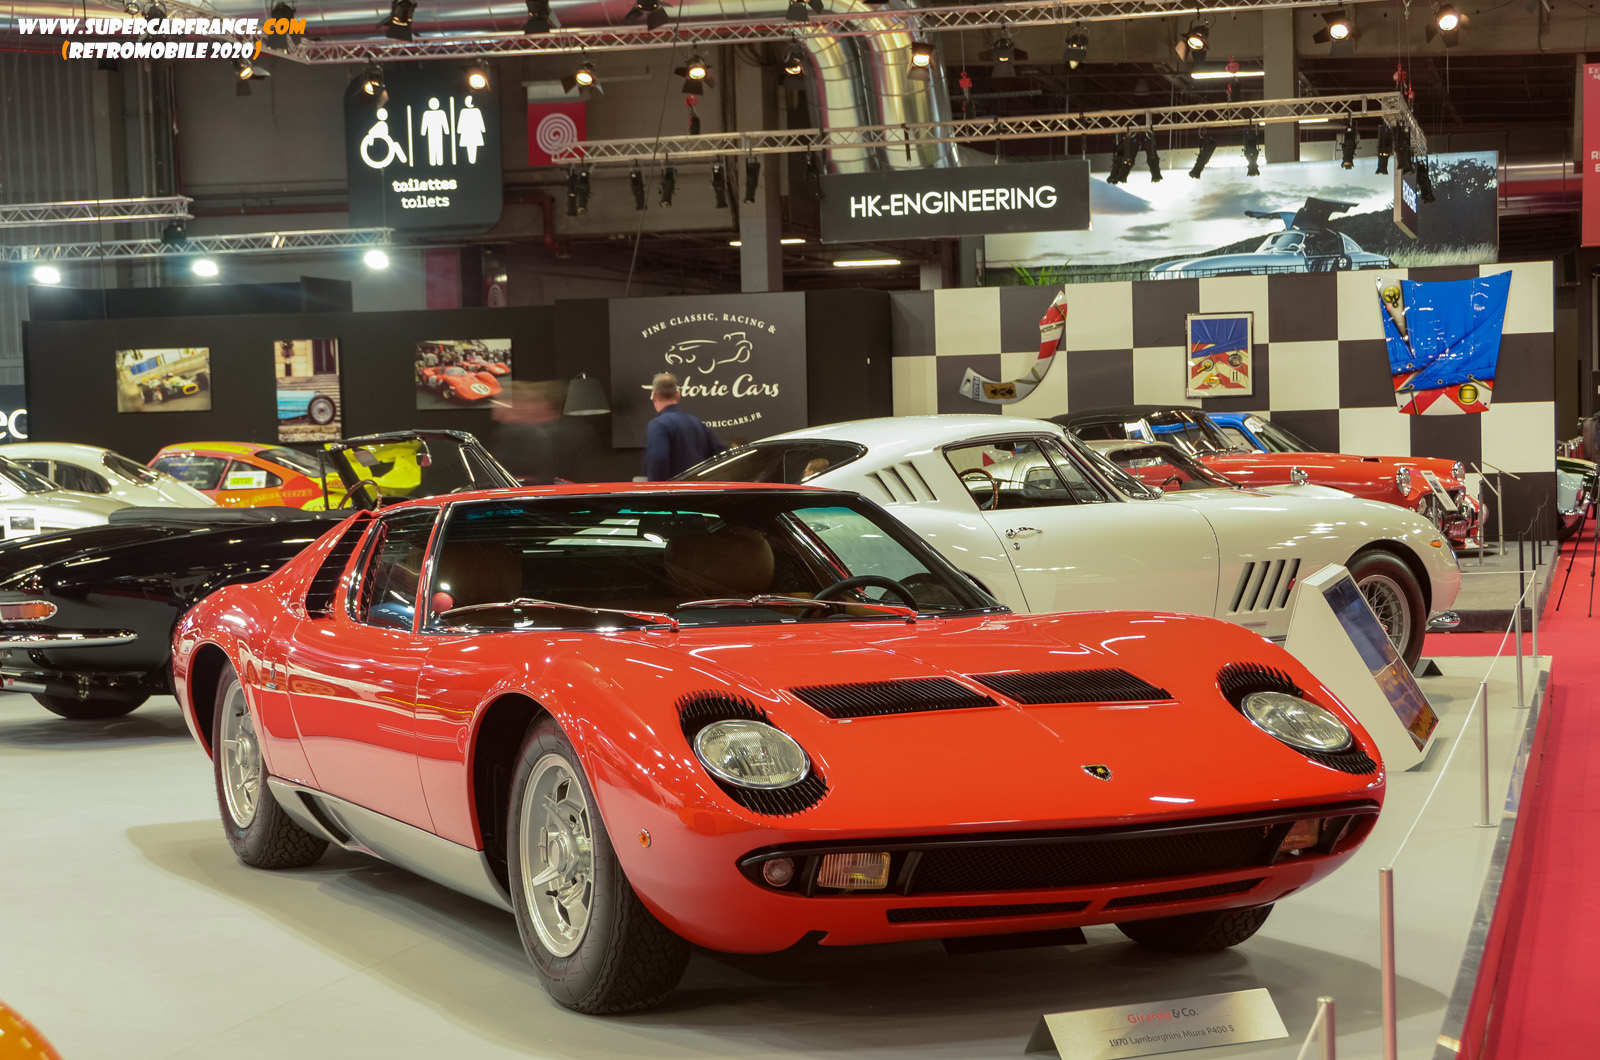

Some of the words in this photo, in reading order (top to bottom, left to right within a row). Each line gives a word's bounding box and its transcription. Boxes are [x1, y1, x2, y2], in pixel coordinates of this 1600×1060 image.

[392, 178, 457, 192] toilettes
[401, 195, 450, 208] toilets
[850, 185, 1058, 218] HK-ENGINEERING
[641, 321, 667, 338] FINE
[669, 312, 719, 326] CLASSIC,
[722, 313, 765, 329] RACING
[768, 324, 776, 334] &
[732, 373, 779, 398] Cars
[701, 411, 762, 428] ORICCARS.FR
[1109, 1037, 1128, 1047] 1970
[1129, 1032, 1182, 1045] Lamborghini
[1182, 1029, 1206, 1038] Miura
[1207, 1025, 1227, 1036] P400
[1228, 1025, 1235, 1033] S
